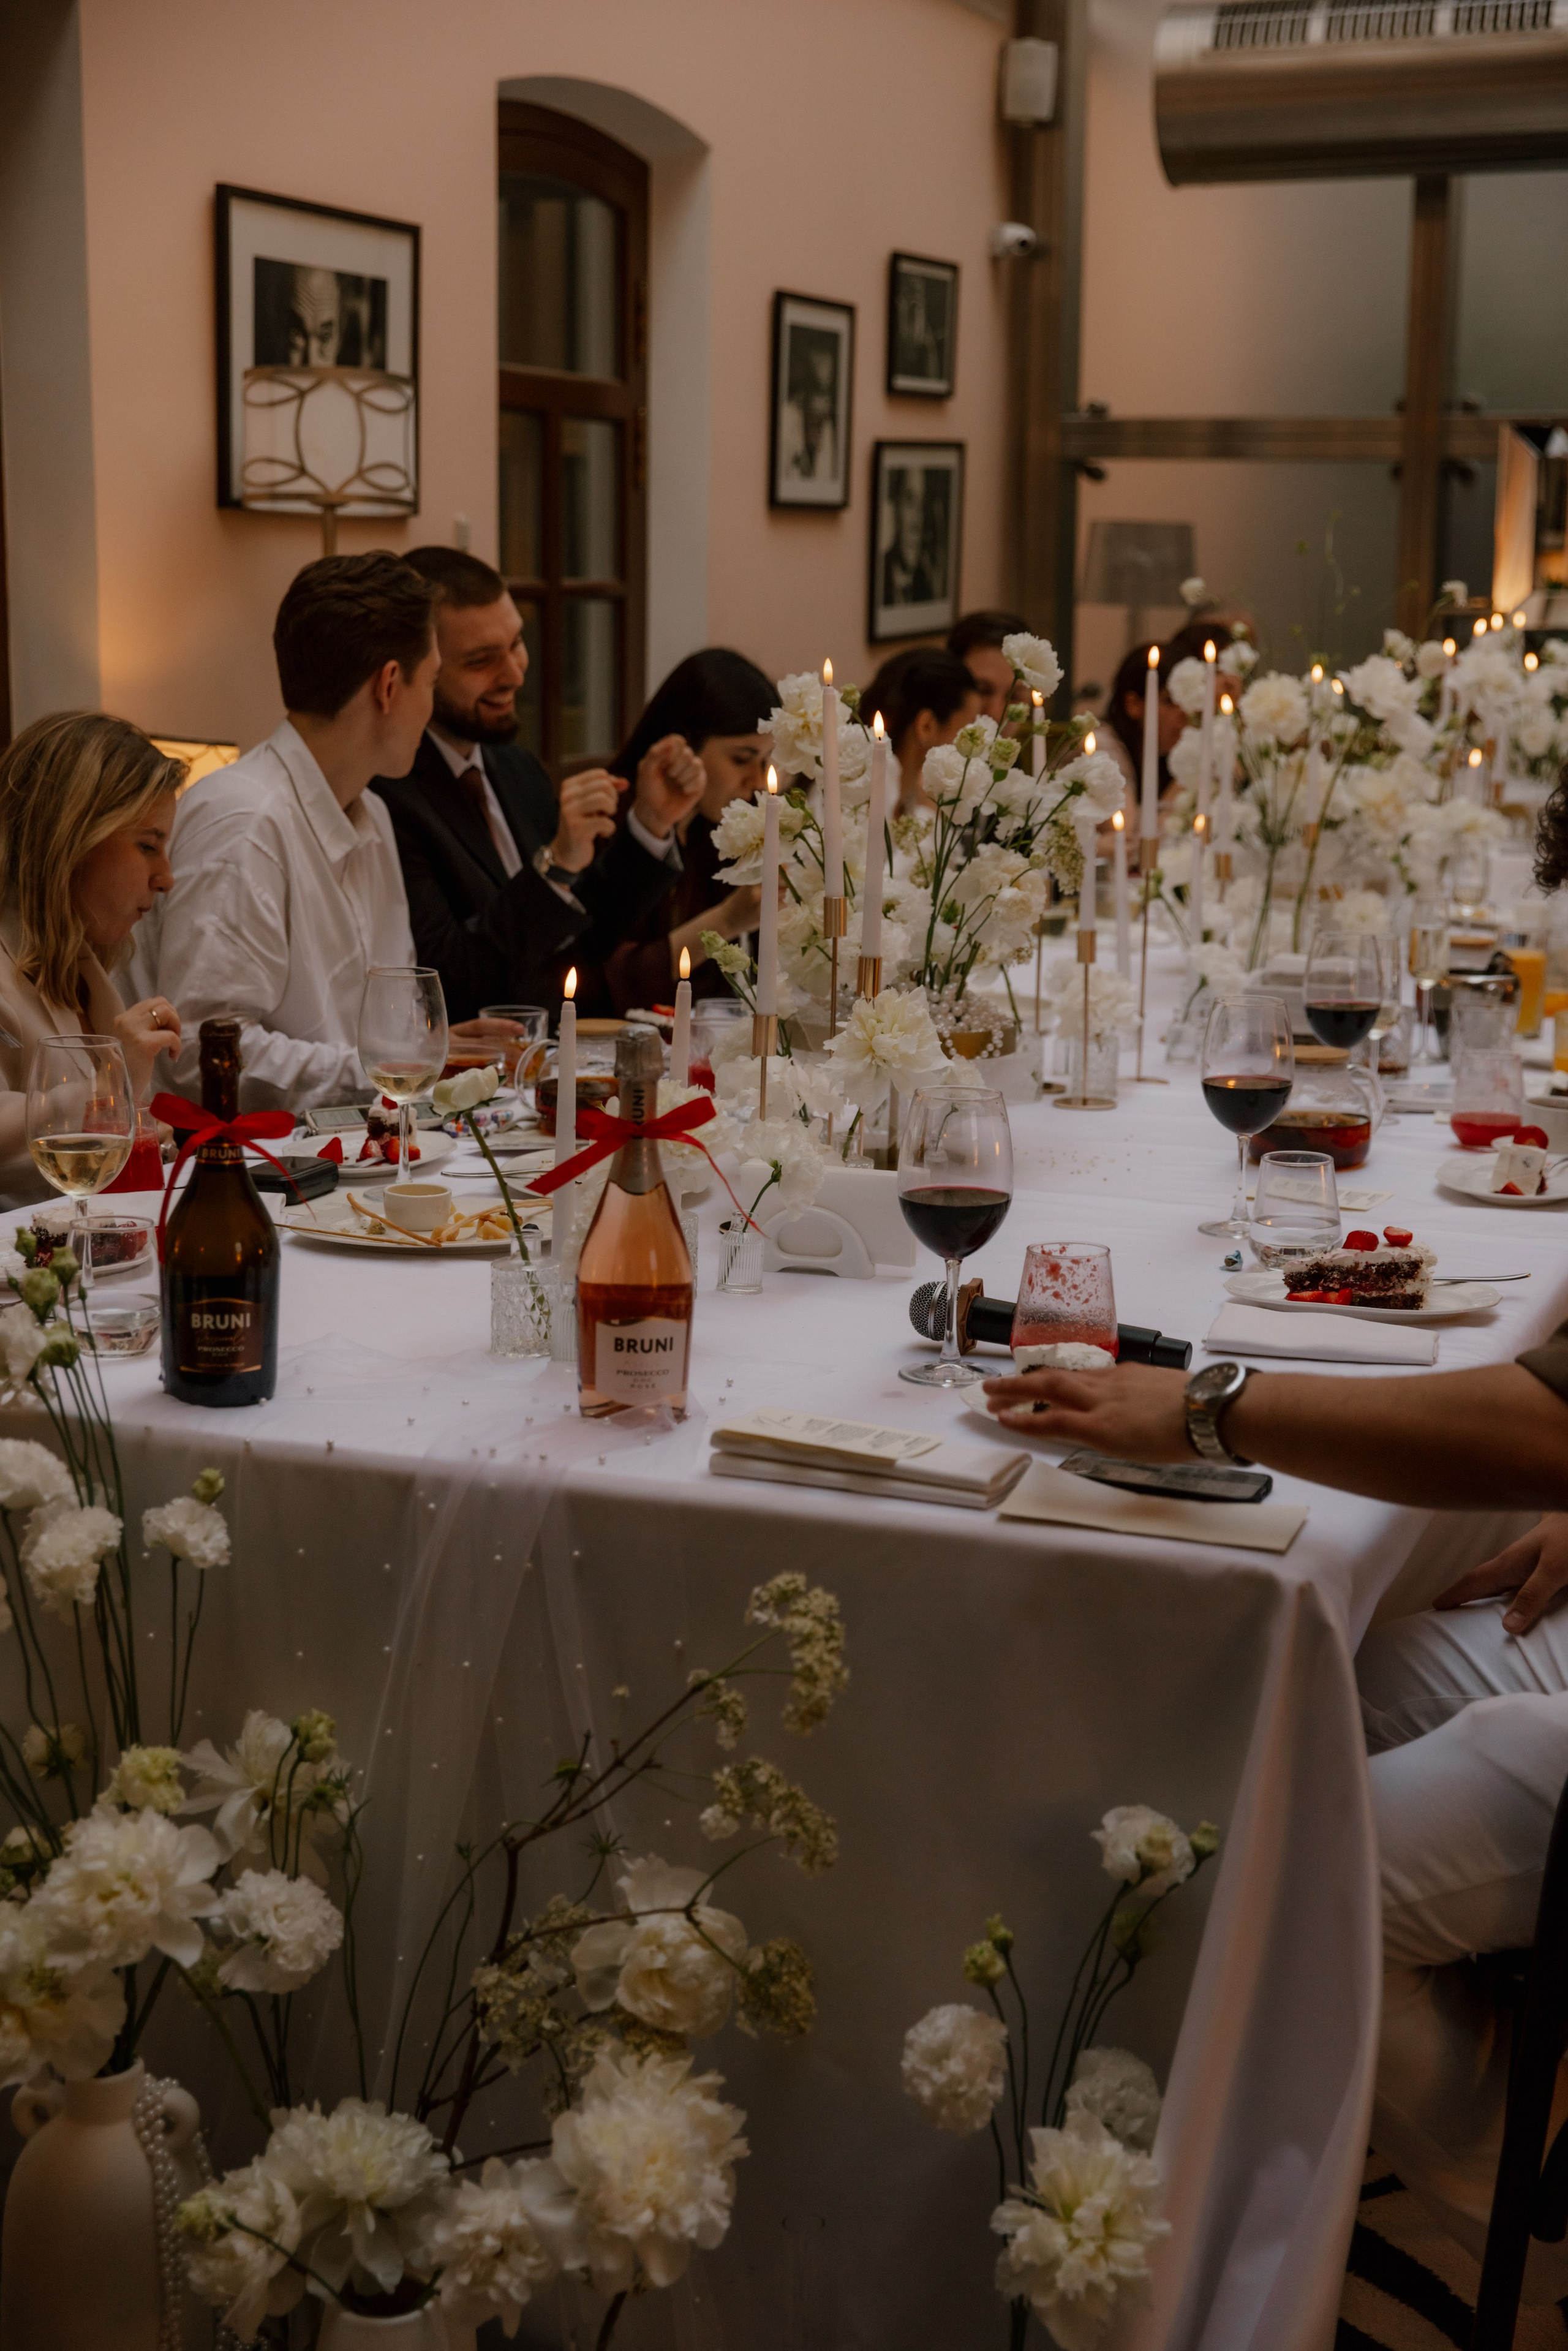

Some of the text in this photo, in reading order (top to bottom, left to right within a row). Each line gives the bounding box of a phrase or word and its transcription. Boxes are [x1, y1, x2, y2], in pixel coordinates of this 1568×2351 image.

[202, 1148, 241, 1159] BRUNI
[191, 1312, 251, 1329] BRUNI
[614, 1337, 673, 1353] BRUNI
